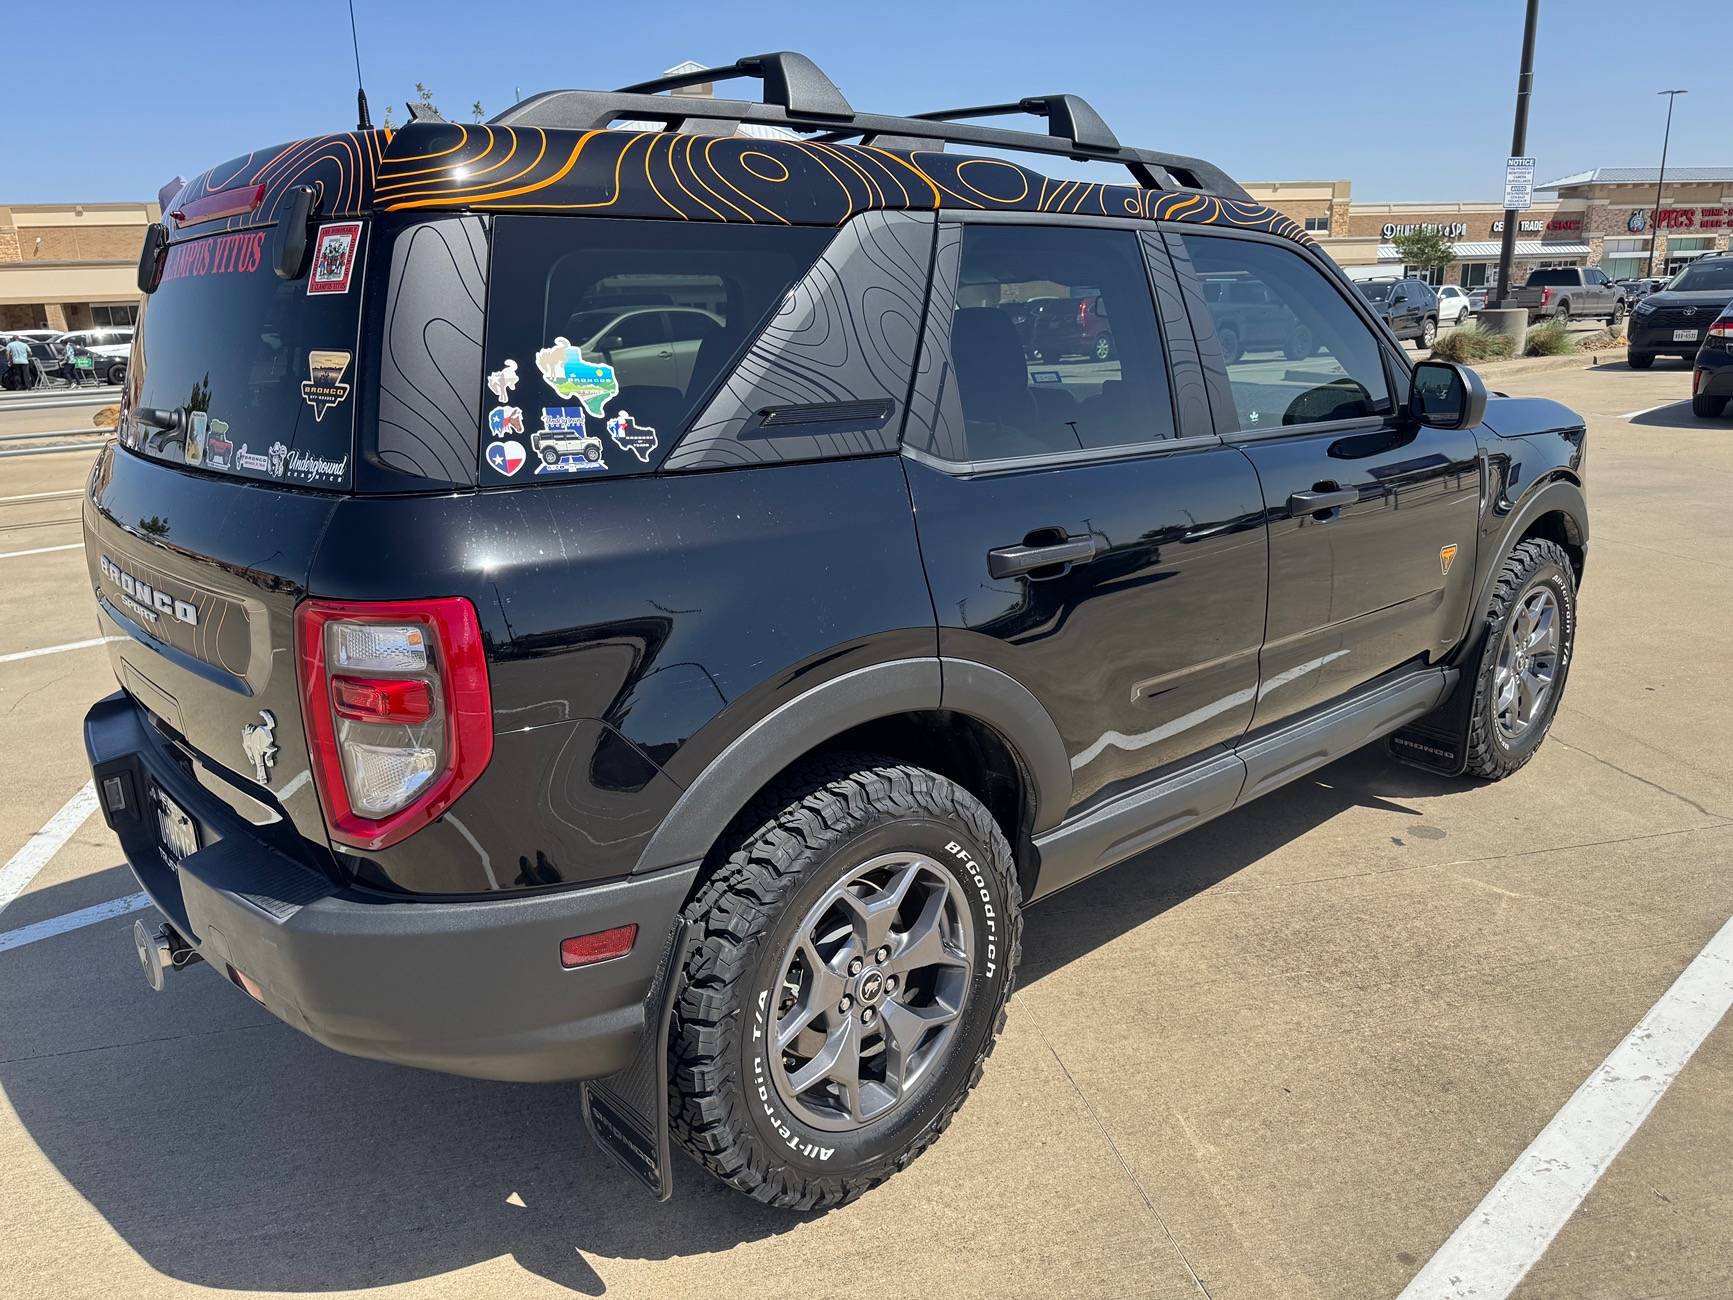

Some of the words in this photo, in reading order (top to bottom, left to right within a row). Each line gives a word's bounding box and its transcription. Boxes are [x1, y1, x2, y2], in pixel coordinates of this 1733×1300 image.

[1520, 220, 1544, 231] TRADE
[1702, 208, 1723, 217] WINE
[1450, 222, 1467, 237] SPA
[212, 232, 266, 273] VITUS
[304, 386, 344, 396] BRONCO
[286, 450, 348, 482] Underground
[100, 554, 197, 626] BRONCO
[121, 593, 157, 623] SPORT
[1561, 641, 1571, 666] T/A
[944, 840, 998, 979] BFGoodrich
[752, 989, 769, 1043] T/A
[753, 1056, 836, 1162] All-Terrain
